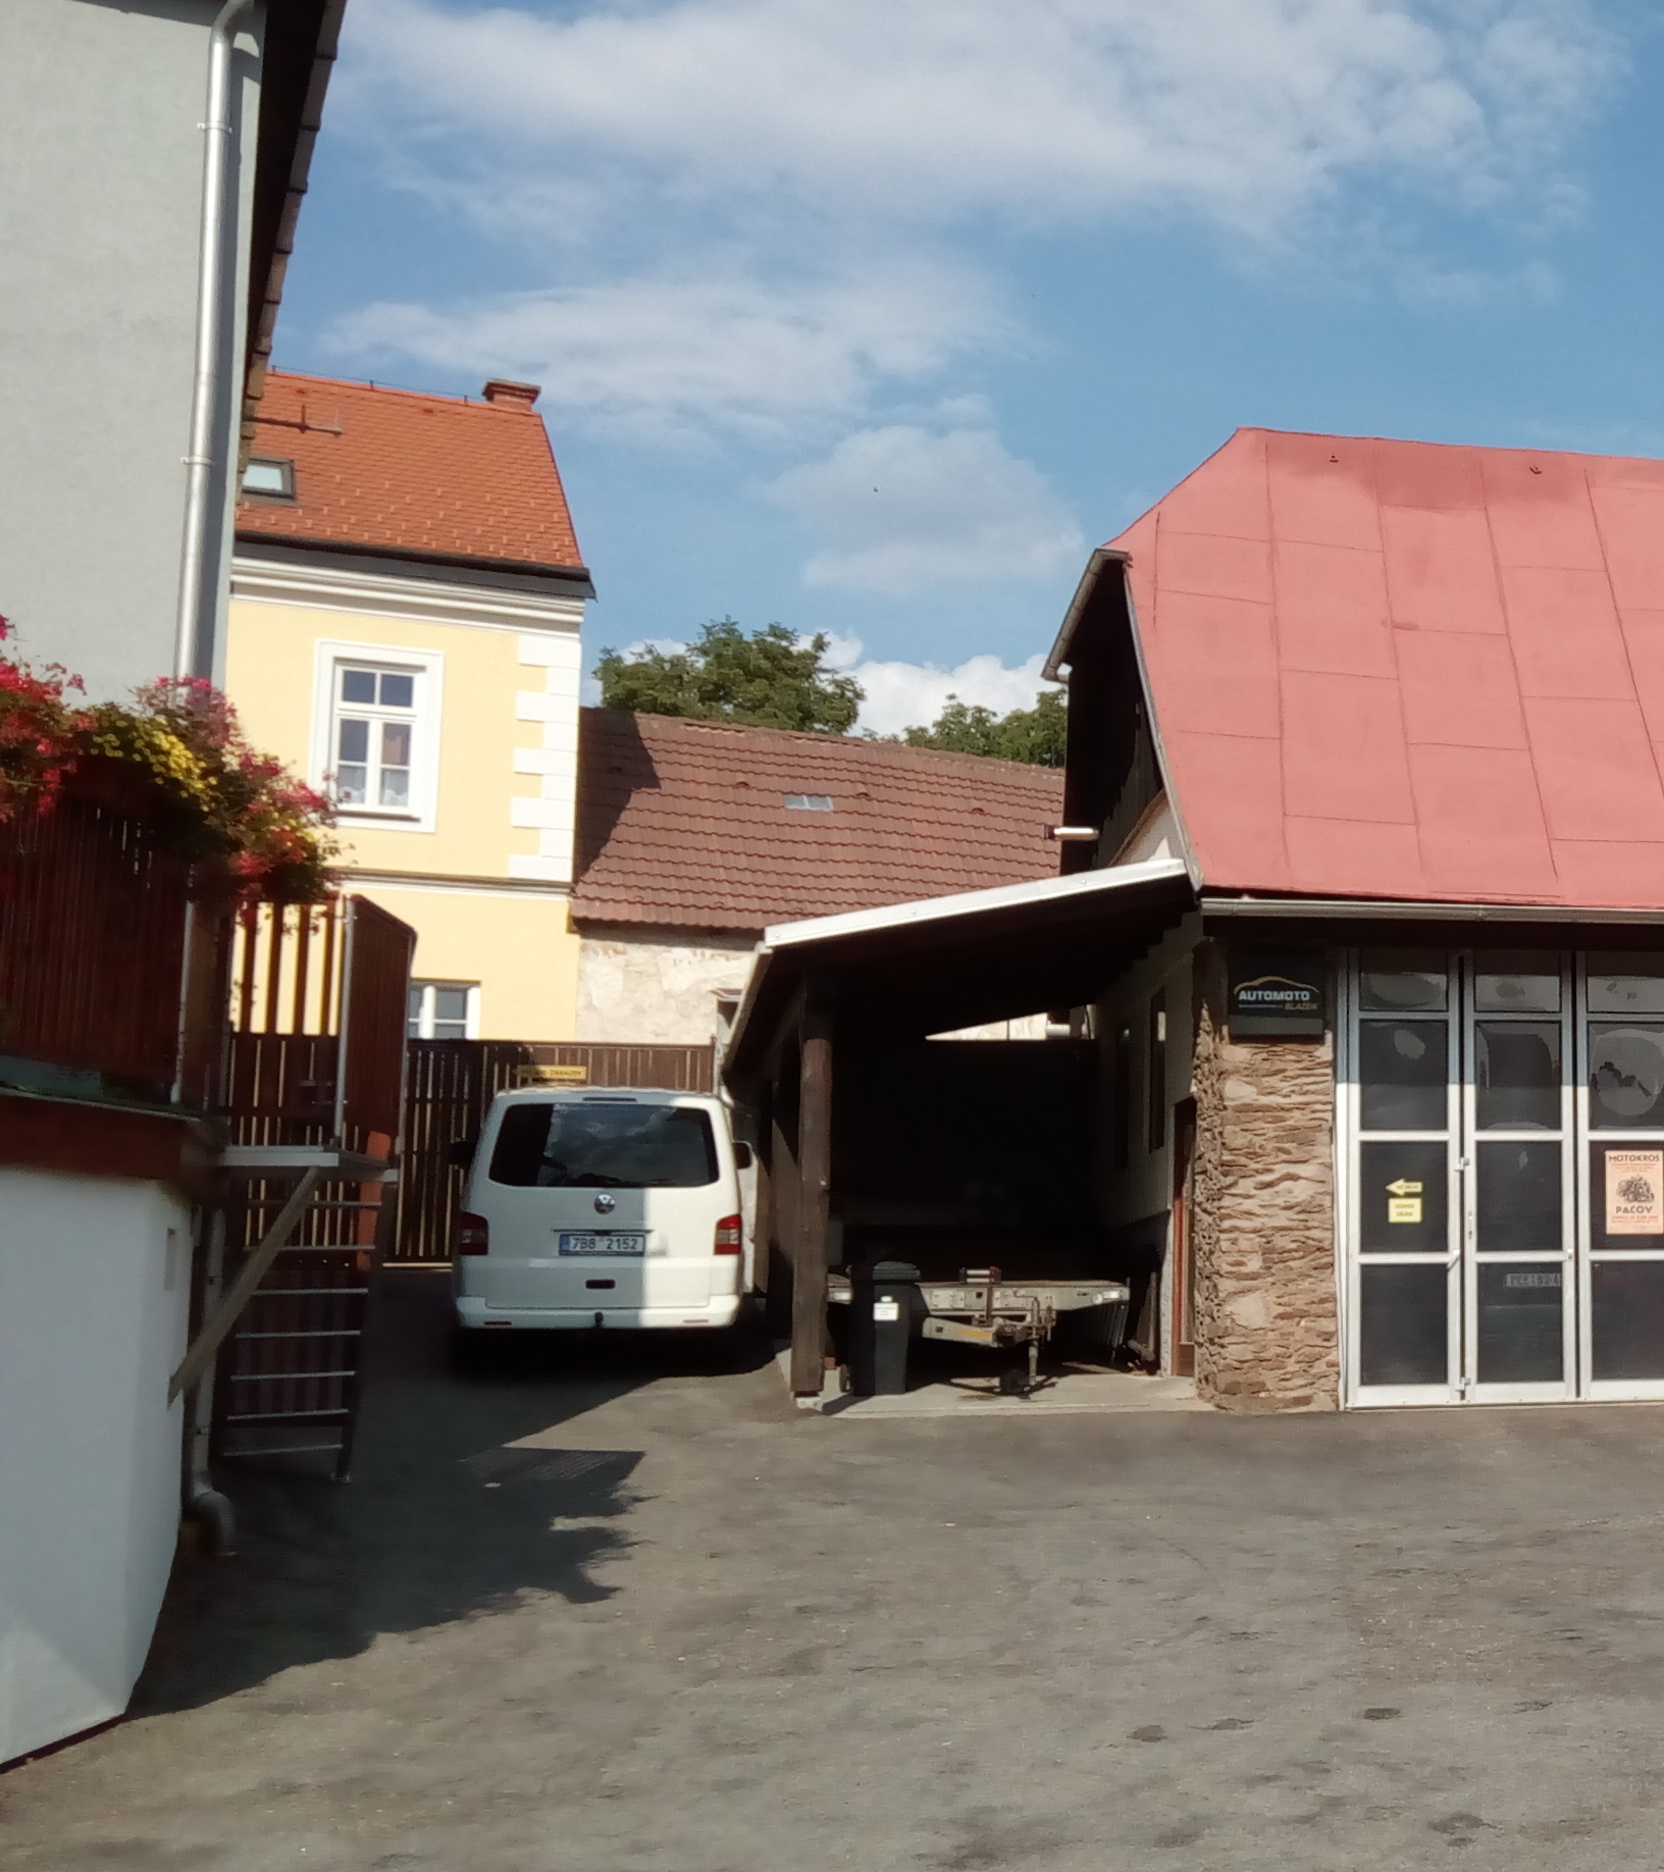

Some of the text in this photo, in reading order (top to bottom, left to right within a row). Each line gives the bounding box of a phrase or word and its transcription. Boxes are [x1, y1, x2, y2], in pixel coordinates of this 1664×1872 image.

[1238, 990, 1311, 1001] AUTOMOTO
[1608, 1154, 1660, 1163] MOTOKROS
[1615, 1205, 1654, 1214] PACOV
[605, 1238, 638, 1250] 2152
